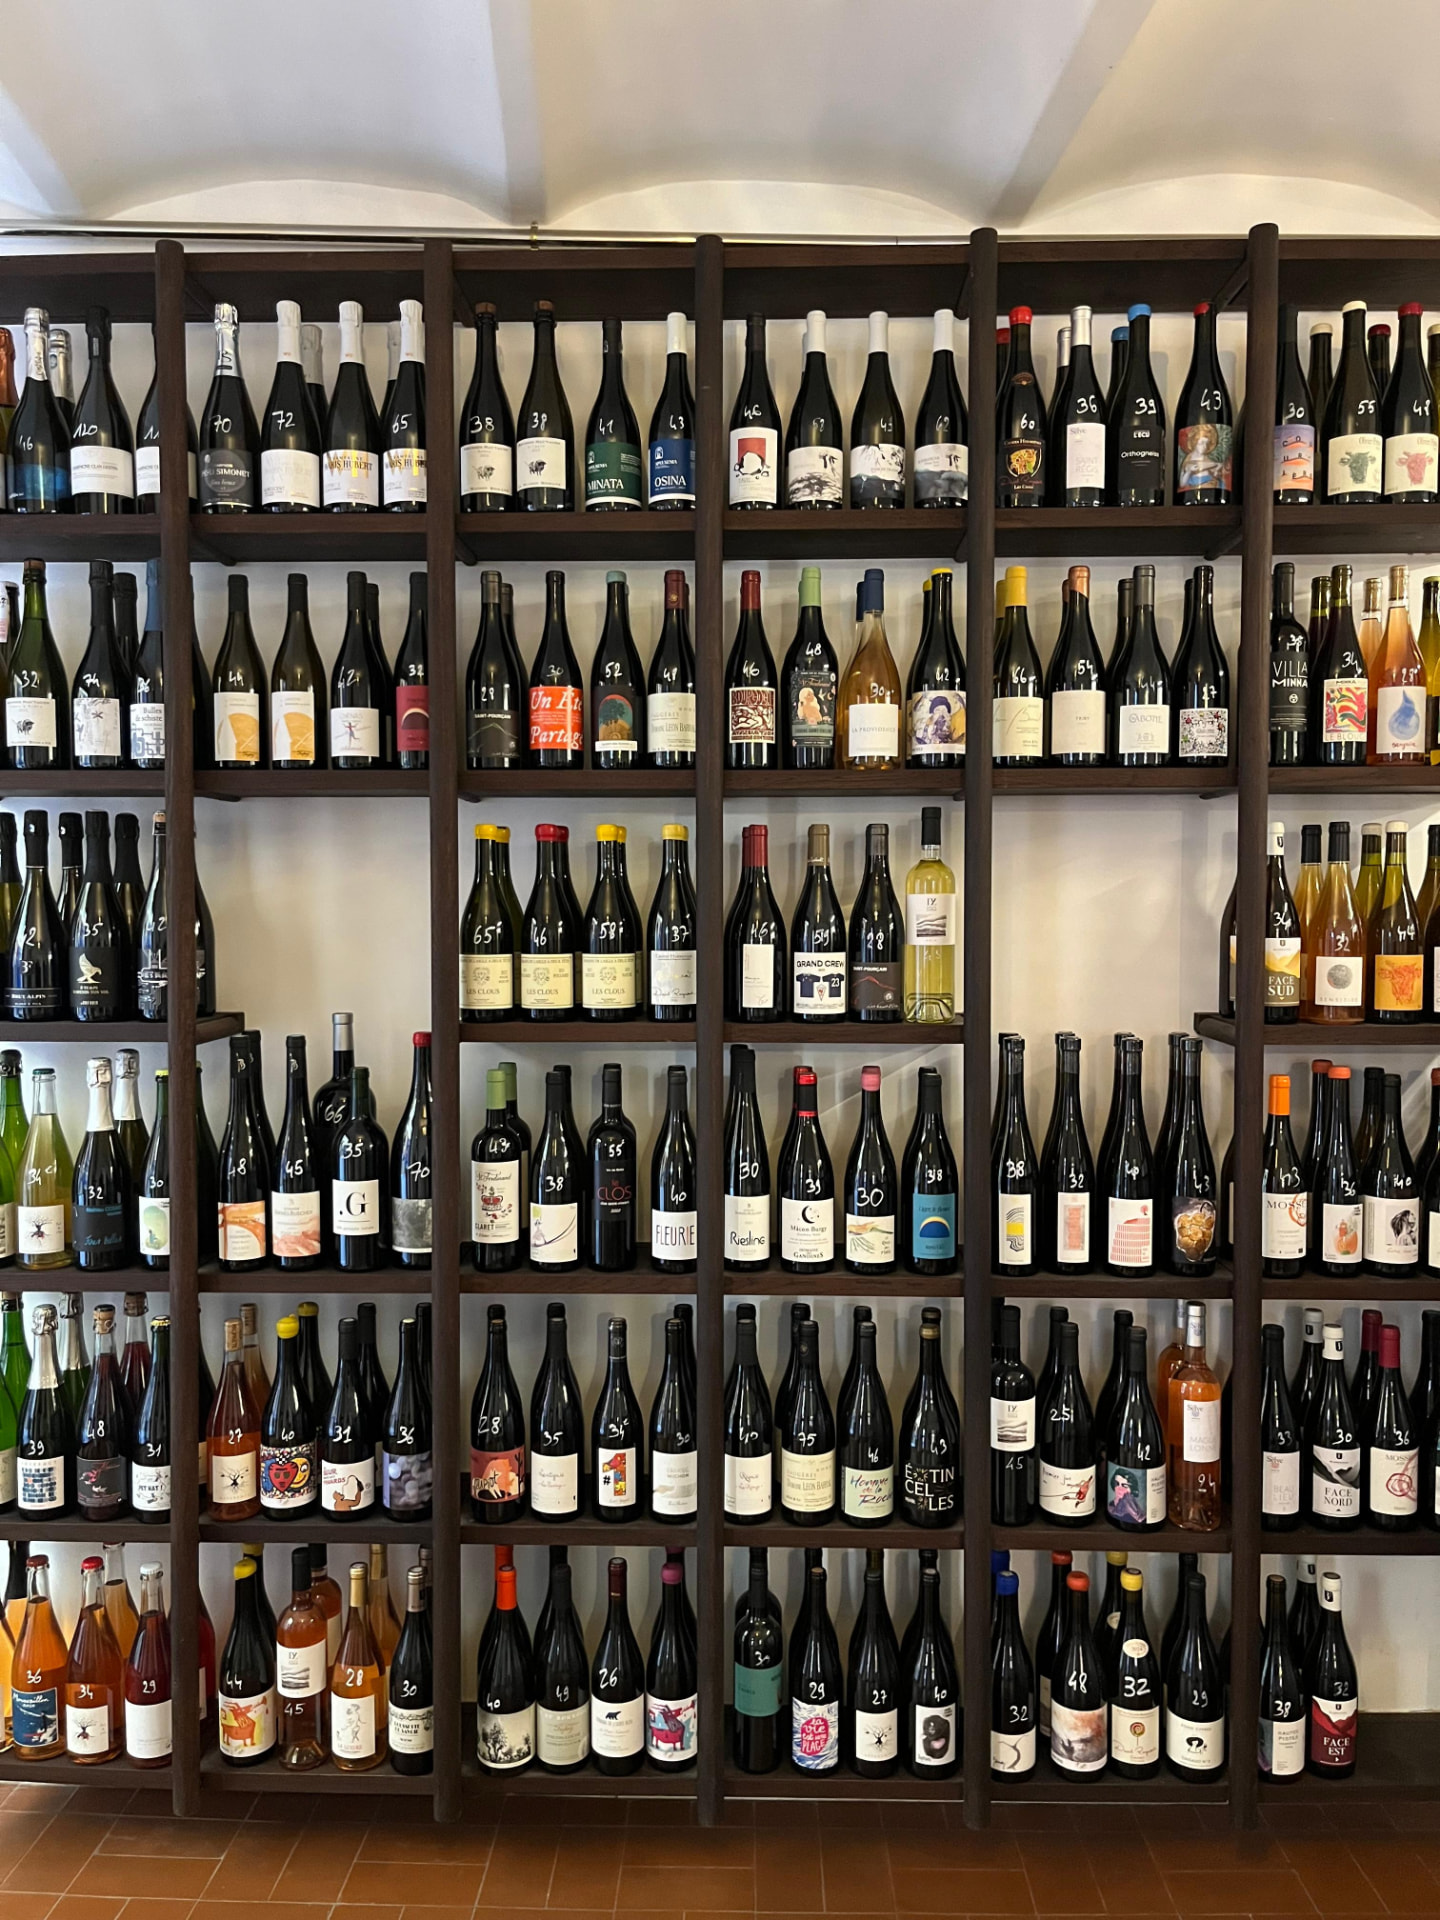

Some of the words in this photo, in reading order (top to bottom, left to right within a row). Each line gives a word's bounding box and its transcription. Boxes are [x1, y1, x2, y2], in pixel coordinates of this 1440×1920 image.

[1076, 395, 1098, 414] 36
[1134, 397, 1157, 414] 39
[1201, 388, 1222, 412] 43
[1358, 400, 1376, 414] 55
[1284, 402, 1304, 420] 30
[272, 410, 296, 430] 72
[392, 413, 412, 434] 65
[470, 416, 494, 434] 38
[532, 412, 548, 432] 38
[600, 418, 614, 435] 41
[670, 414, 685, 430] 43
[1020, 413, 1035, 430] 60
[588, 478, 624, 490] MINATA
[654, 475, 686, 487] OSINA
[805, 642, 822, 656] 48
[742, 660, 760, 677] 46
[1078, 660, 1094, 676] 54
[1272, 660, 1308, 678] VILLA
[1342, 652, 1359, 670] 34
[408, 664, 424, 677] 32
[546, 664, 564, 677] 30
[604, 662, 623, 678] 52
[22, 670, 39, 688] 32
[1272, 678, 1308, 688] MINNA
[1273, 912, 1292, 930] 34
[474, 926, 496, 944] 65
[533, 926, 547, 947] 46
[600, 922, 616, 939] 58
[866, 929, 884, 950] 28
[796, 960, 823, 968] GRAND
[824, 960, 844, 968] CREW
[830, 978, 840, 988] 23
[1268, 976, 1294, 985] FACE
[1268, 986, 1294, 996] SUD
[325, 1104, 346, 1124] 66
[342, 1142, 364, 1158] 35
[608, 1142, 624, 1158] 55
[285, 1159, 304, 1178] 45
[408, 1162, 430, 1182] 70
[739, 1162, 759, 1180] 30
[926, 1168, 943, 1184] 38
[1006, 1160, 1025, 1179] 38
[150, 1176, 164, 1189] 30
[545, 1176, 564, 1192] 38
[1070, 1174, 1084, 1189] 32
[88, 1186, 104, 1200] 32
[597, 1185, 632, 1200] CLOS
[670, 1188, 687, 1206] 40
[856, 1187, 884, 1207] 30
[656, 1224, 695, 1246] FLEURIE
[730, 1232, 766, 1246] Riesling
[86, 1420, 104, 1440] 48
[478, 1416, 500, 1434] 28
[228, 1428, 243, 1444] 27
[281, 1428, 295, 1442] 40
[332, 1426, 352, 1444] 31
[396, 1426, 416, 1444] 36
[544, 1431, 564, 1446] 35
[676, 1432, 690, 1446] 30
[798, 1431, 817, 1448] 75
[930, 1432, 948, 1454] 43
[1278, 1430, 1294, 1445] 33
[1332, 1428, 1352, 1446] 30
[1394, 1430, 1410, 1446] 36
[28, 1440, 44, 1456] 39
[146, 1444, 162, 1457] 31
[868, 1447, 878, 1463] 46
[1137, 1444, 1152, 1462] 42
[1006, 1456, 1024, 1470] 45
[904, 1480, 934, 1498] CEL
[1324, 1486, 1352, 1496] FACE
[928, 1496, 954, 1512] LES
[1324, 1496, 1352, 1506] NORD
[26, 1668, 42, 1684] 36
[226, 1672, 242, 1690] 44
[346, 1668, 364, 1688] 28
[599, 1666, 618, 1690] 26
[1068, 1671, 1088, 1693] 48
[78, 1684, 94, 1700] 34
[142, 1680, 156, 1694] 29
[400, 1680, 418, 1698] 30
[556, 1685, 570, 1702] 49
[808, 1682, 826, 1700] 29
[934, 1686, 947, 1702] 40
[1124, 1676, 1151, 1697] 32
[1334, 1681, 1349, 1696] 32
[486, 1693, 500, 1711] 40
[872, 1689, 888, 1705] 27
[1192, 1690, 1208, 1708] 29
[284, 1702, 306, 1716] 45
[1010, 1706, 1028, 1723] 32
[1274, 1700, 1292, 1718] 38
[802, 1739, 826, 1752] PLAGE
[1323, 1737, 1350, 1746] FACE
[1328, 1746, 1346, 1756] EST
